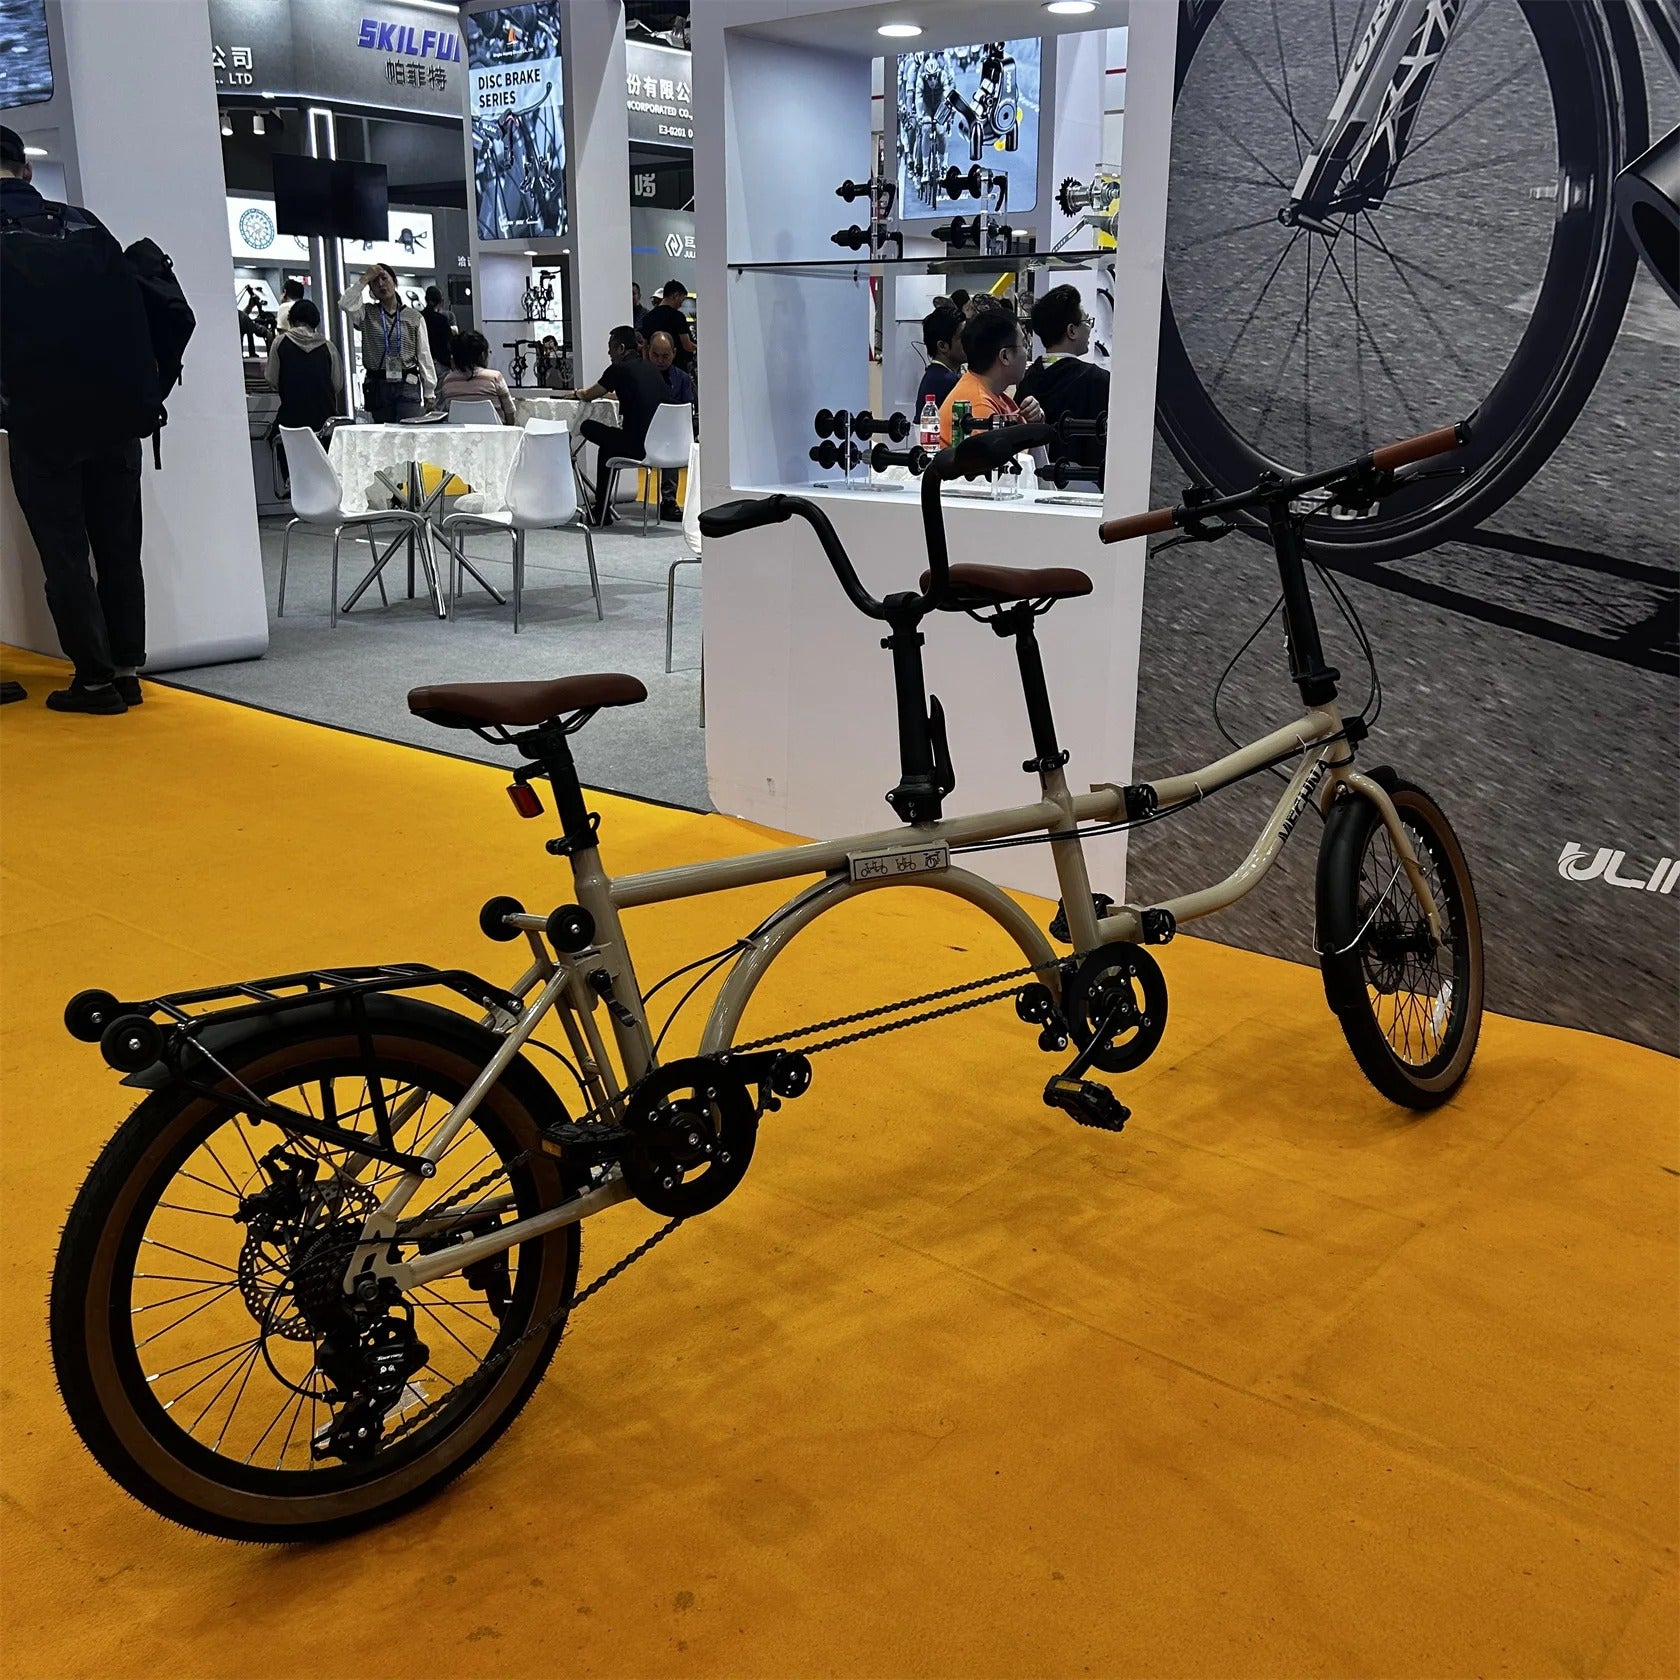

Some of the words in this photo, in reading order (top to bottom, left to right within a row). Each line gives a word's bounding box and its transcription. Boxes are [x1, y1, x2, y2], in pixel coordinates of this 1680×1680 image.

[228, 72, 253, 85] LTD
[384, 58, 448, 92] 帕菲特
[478, 73, 503, 91] DISC
[505, 68, 541, 87] BRAKE
[479, 90, 516, 108] SERIES
